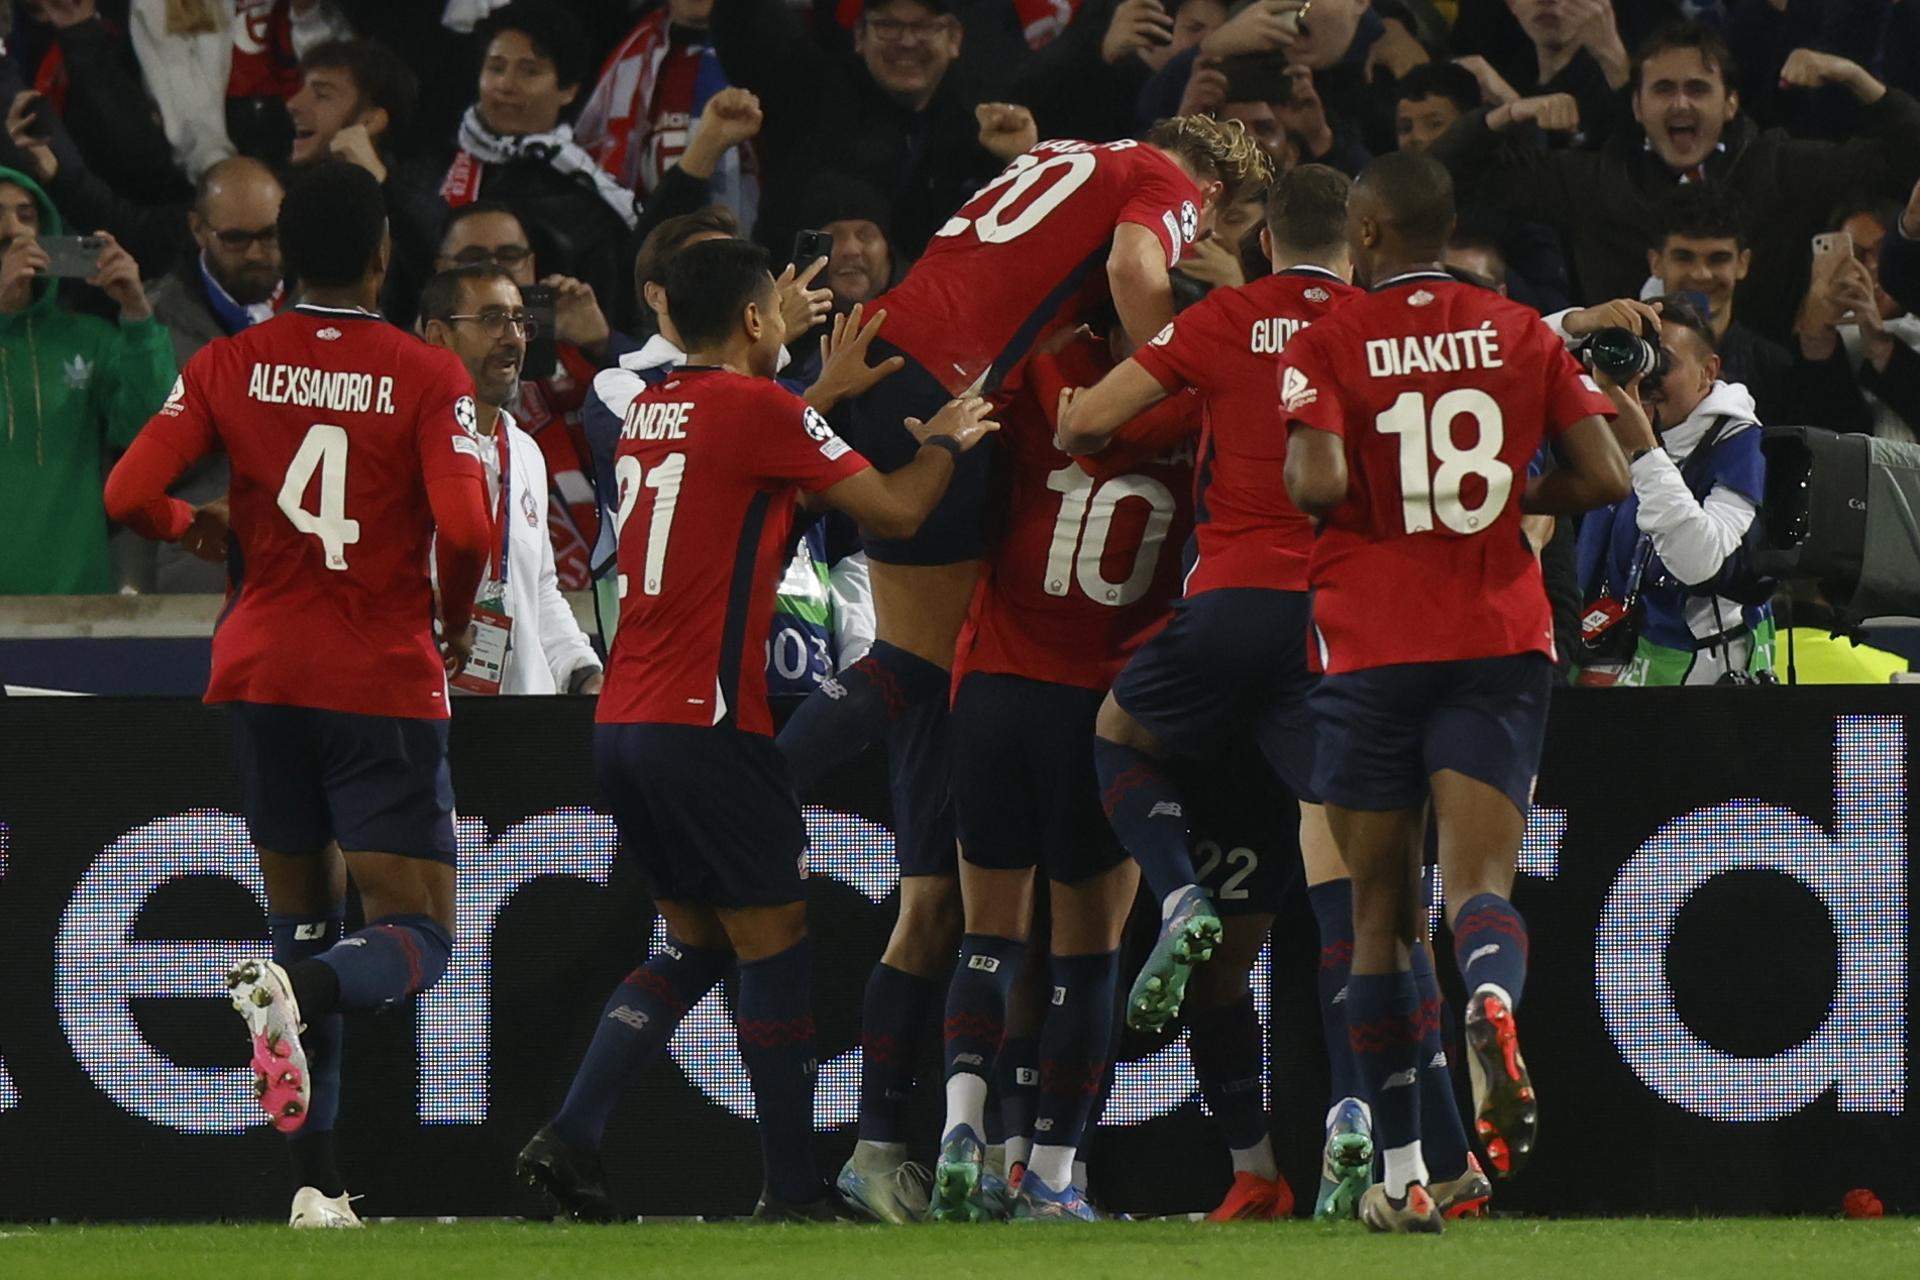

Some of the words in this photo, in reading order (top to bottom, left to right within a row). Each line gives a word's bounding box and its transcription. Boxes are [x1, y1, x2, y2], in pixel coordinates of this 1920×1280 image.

[248, 362, 372, 413] ALEXSANDRO
[376, 376, 395, 415] R.
[1366, 320, 1503, 377] DIAKITÉ
[276, 423, 361, 571] 4
[1375, 388, 1514, 535] 18
[1043, 461, 1177, 607] 10
[1195, 840, 1259, 899] 22
